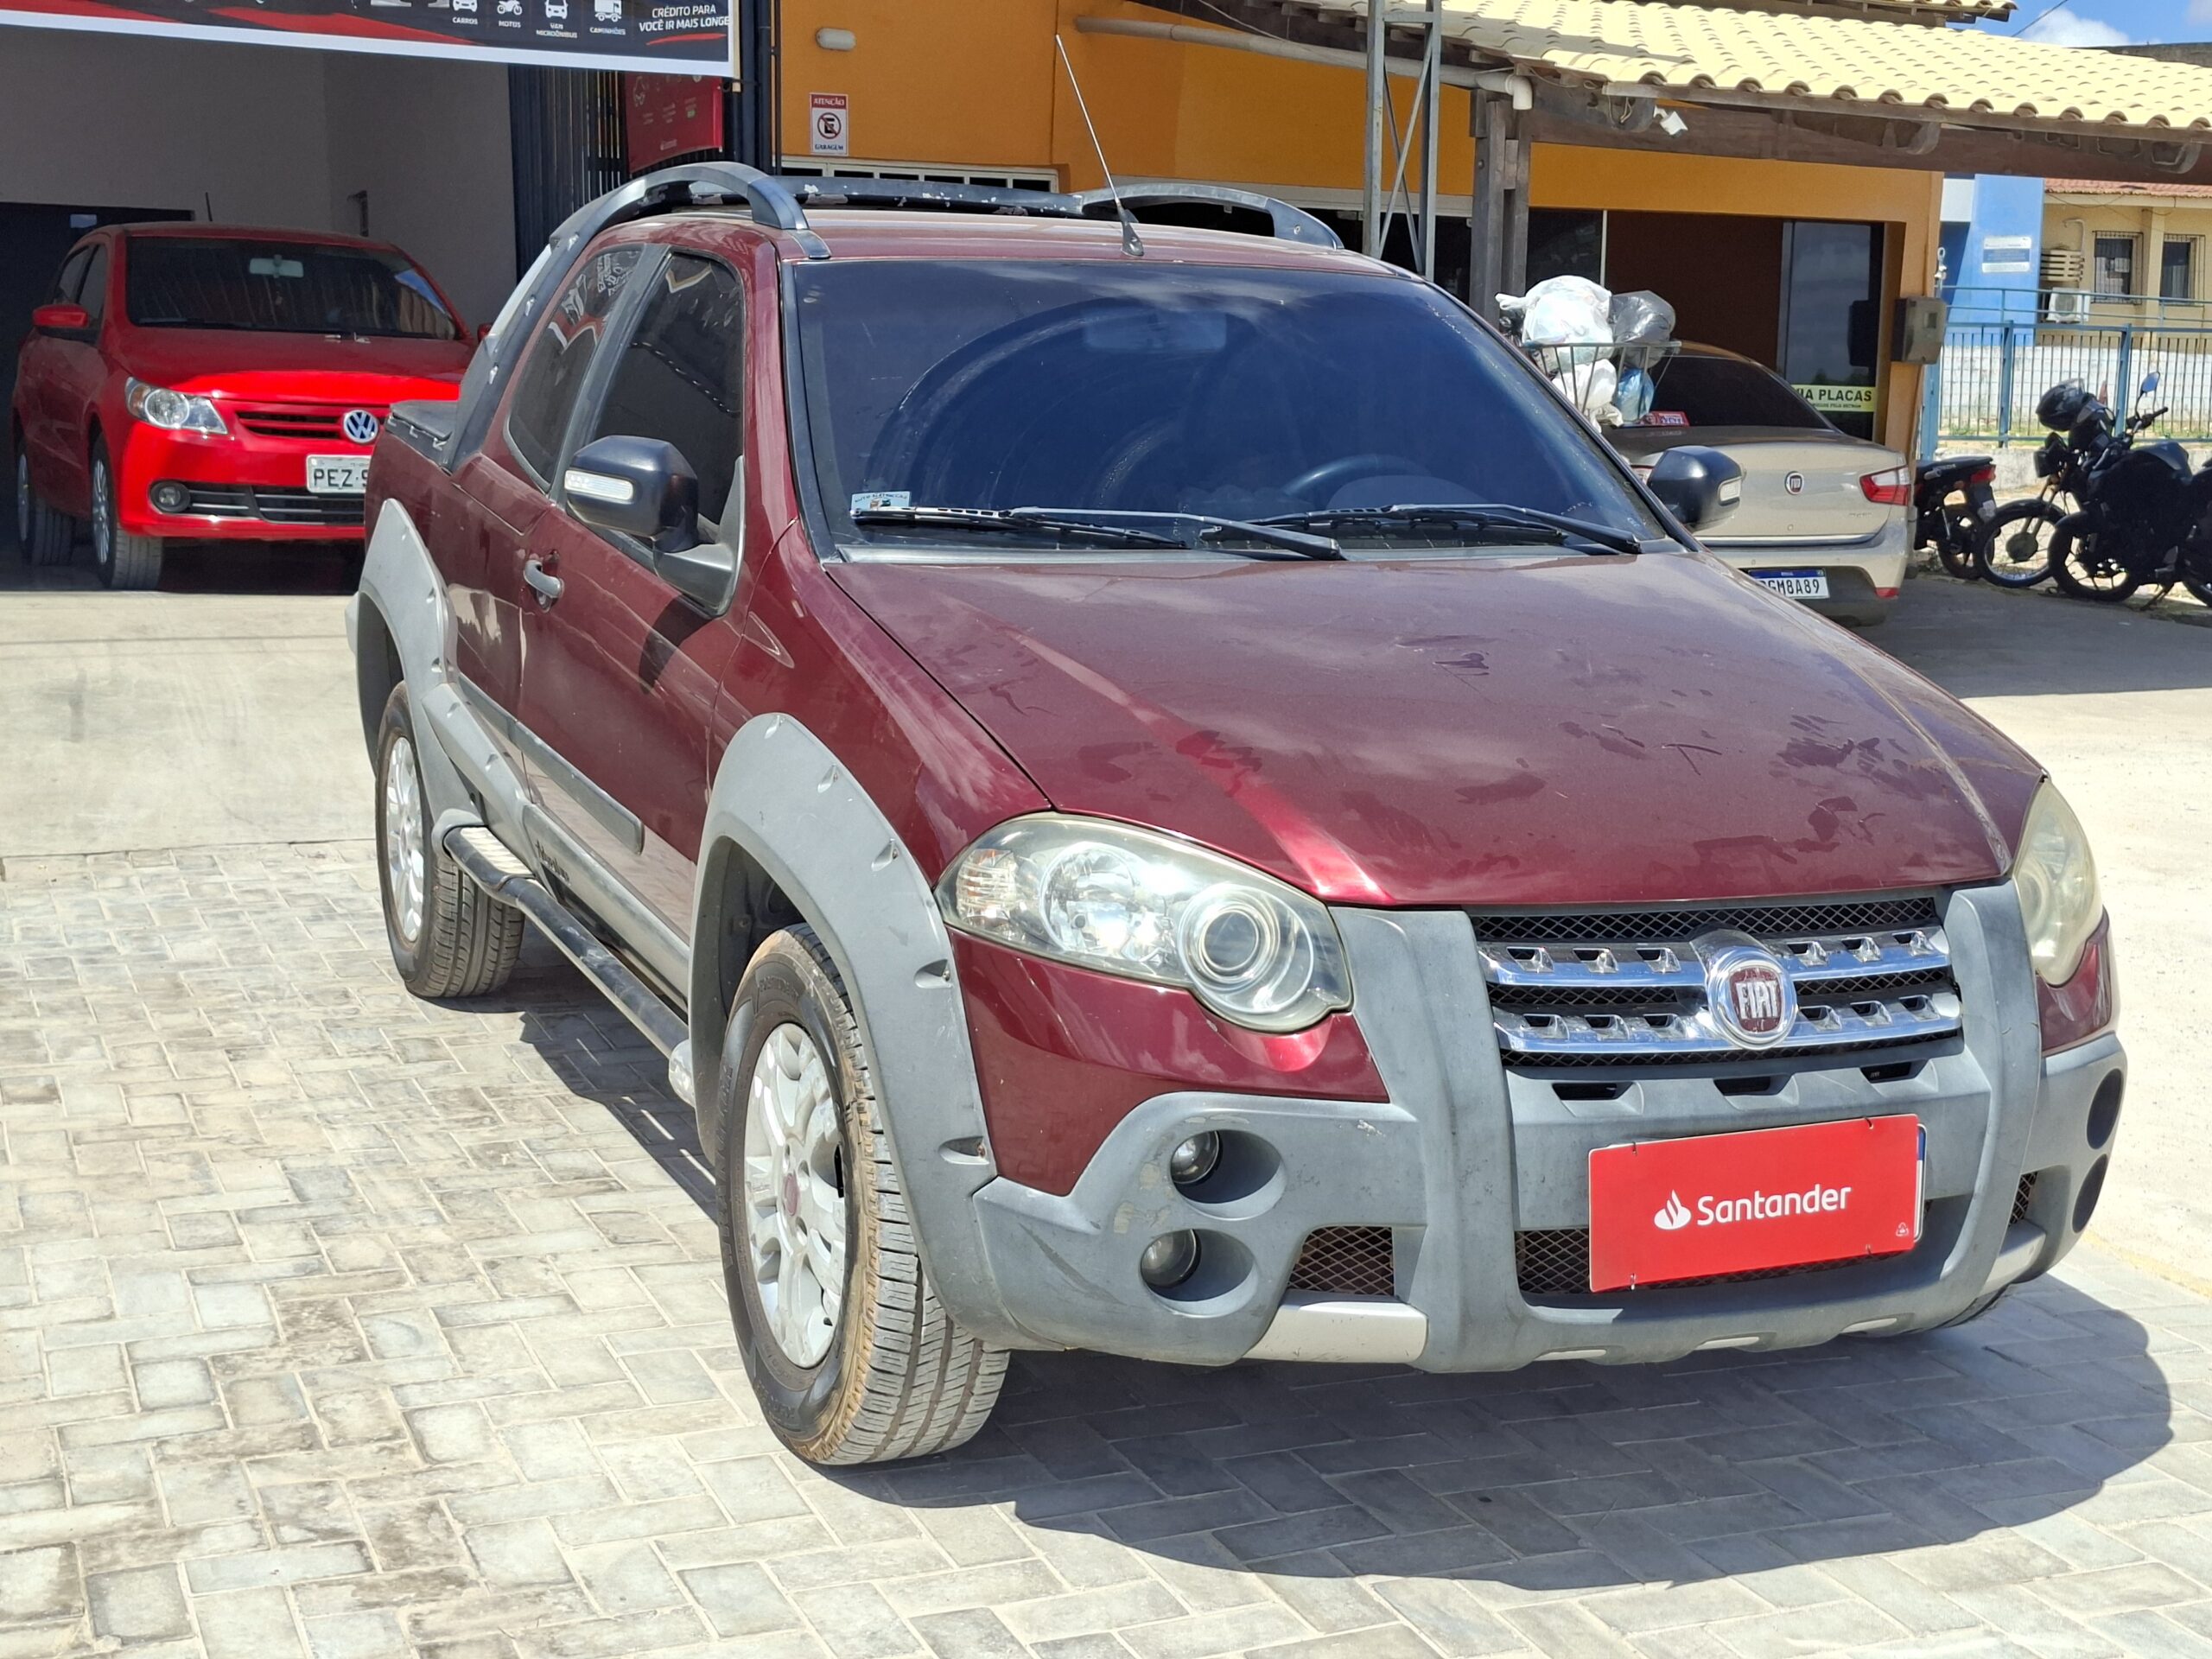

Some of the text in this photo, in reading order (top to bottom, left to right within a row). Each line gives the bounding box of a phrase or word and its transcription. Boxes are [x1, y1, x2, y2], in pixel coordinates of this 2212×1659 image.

[652, 4, 716, 18] CRÉDITO PARA
[452, 16, 479, 25] CARROS
[639, 16, 729, 32] VOCÊ IR MAIS LONGE
[1819, 389, 1872, 402] PLACAS
[1736, 979, 1780, 1020] FIAT
[1697, 1183, 1852, 1226] Santander
